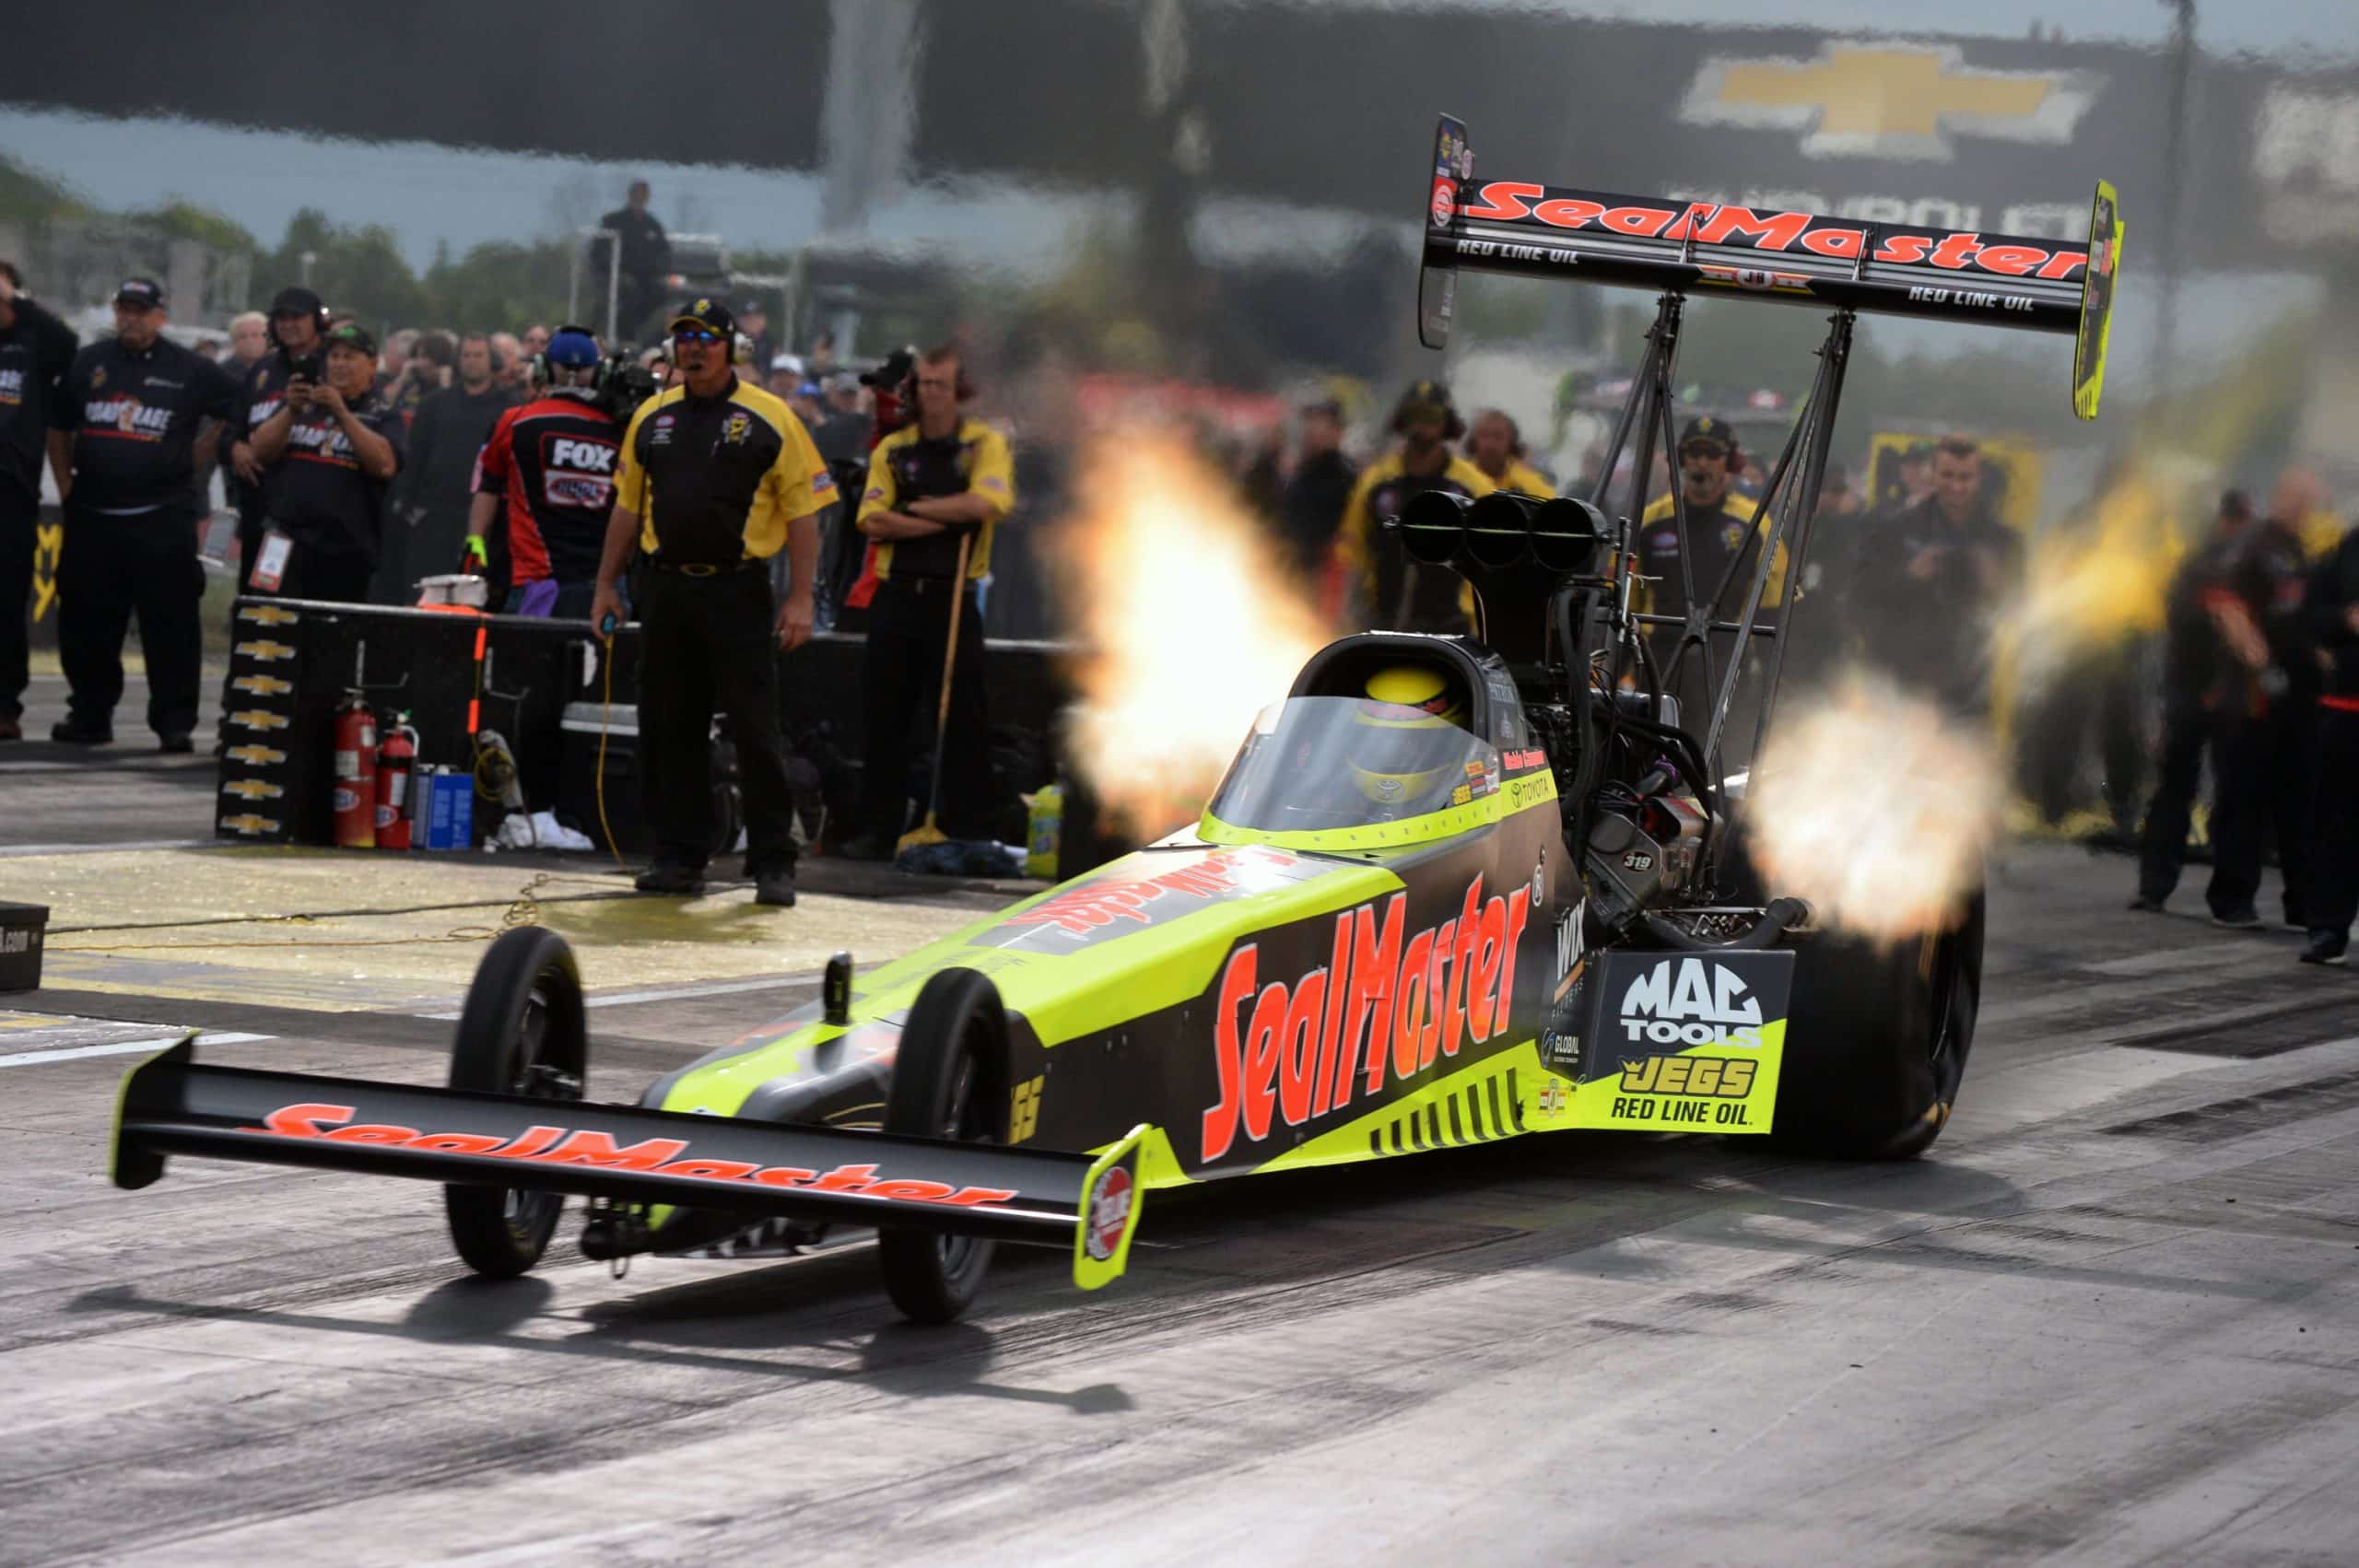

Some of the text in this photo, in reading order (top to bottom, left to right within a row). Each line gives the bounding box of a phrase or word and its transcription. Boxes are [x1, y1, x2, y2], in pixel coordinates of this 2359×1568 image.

[1465, 181, 2090, 279] SealMaster
[1456, 239, 1579, 264] RED LINE OIL
[1907, 286, 2035, 311] RED LINE OIL
[552, 439, 616, 472] FOX
[1522, 776, 1549, 802] TOYOTA
[1556, 895, 1587, 981] WIX
[1620, 957, 1763, 1025] MAC
[1201, 871, 1532, 1164] SealMaster
[1620, 1018, 1763, 1049] TOOLS
[1555, 1034, 1580, 1055] GLOBAL
[1619, 1056, 1759, 1099] JEGS
[1612, 1097, 1656, 1119] RED
[1661, 1100, 1711, 1123] LINE
[234, 1101, 1020, 1209] SealMaster
